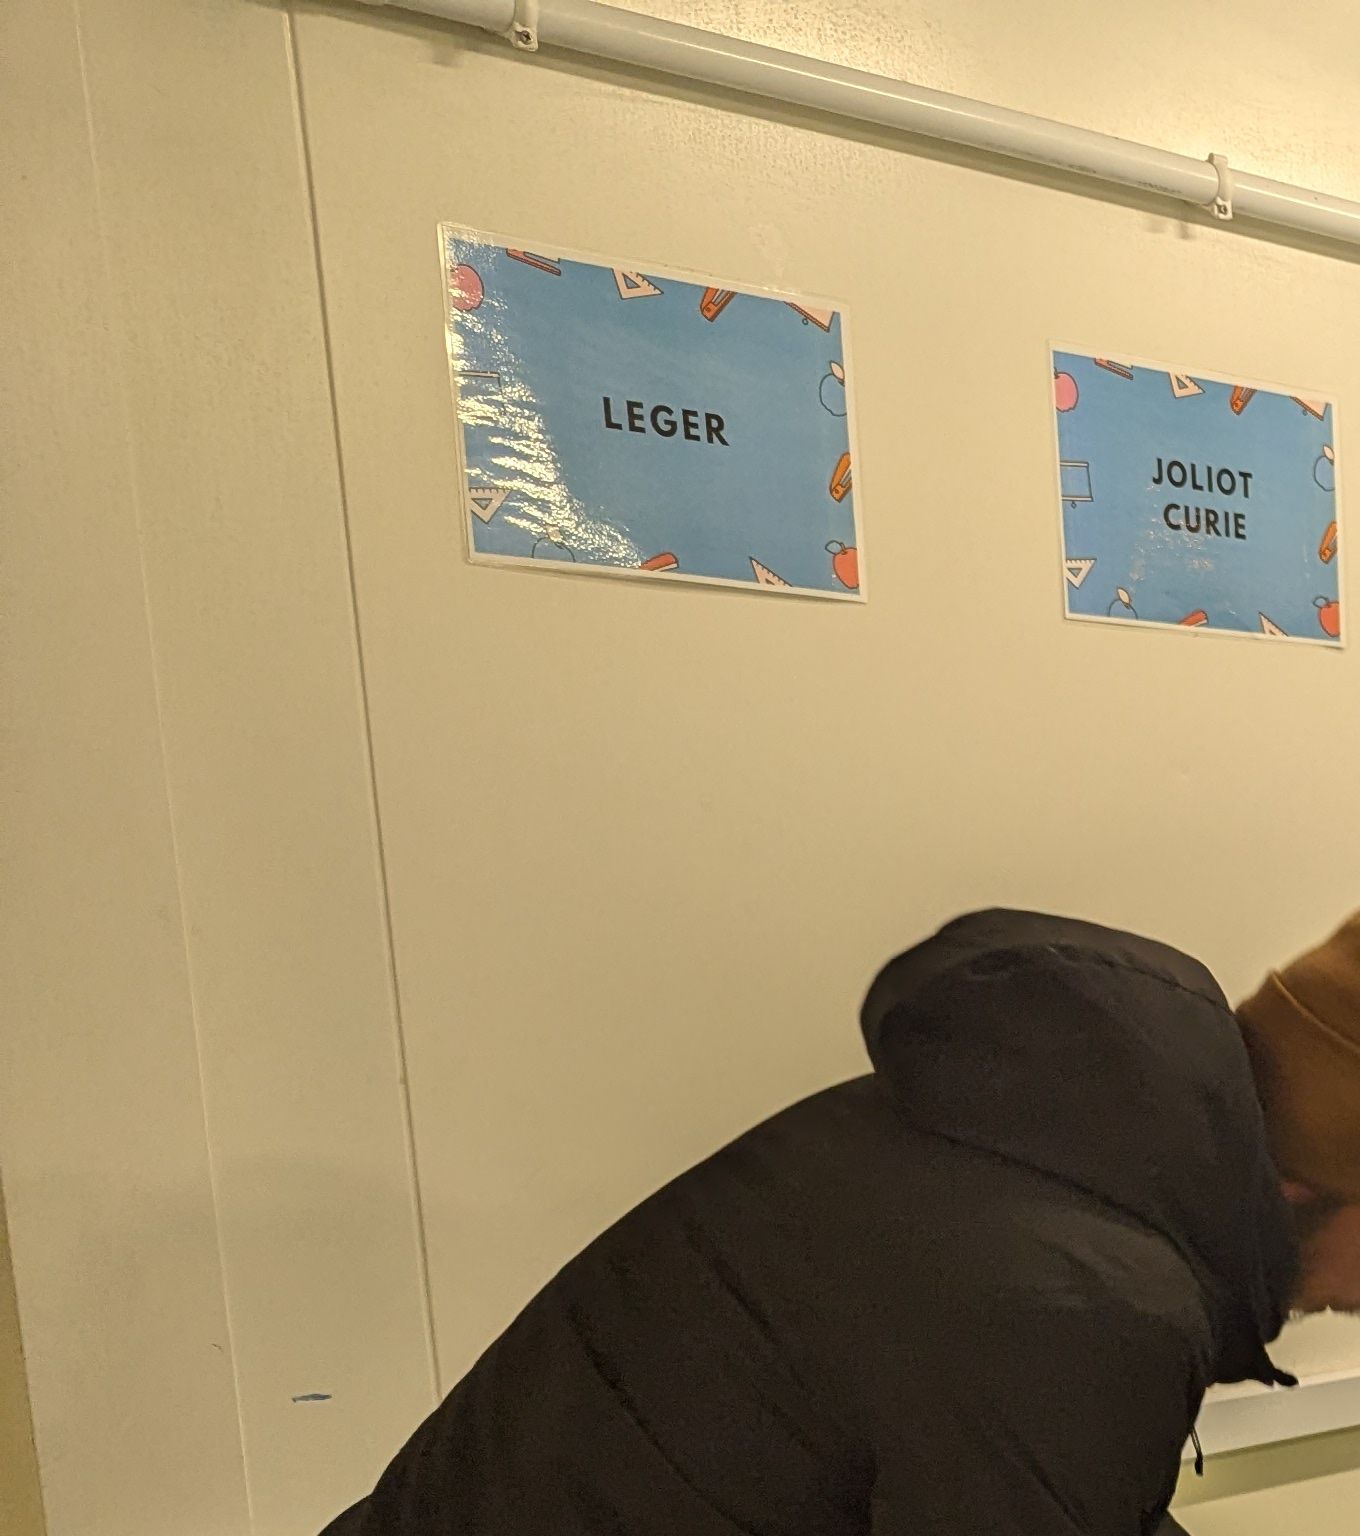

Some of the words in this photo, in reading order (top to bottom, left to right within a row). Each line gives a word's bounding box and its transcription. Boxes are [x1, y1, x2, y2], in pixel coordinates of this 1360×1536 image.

[602, 396, 730, 447] LEGER
[1152, 456, 1253, 500] JOLIOT
[1162, 503, 1248, 541] CURIE
